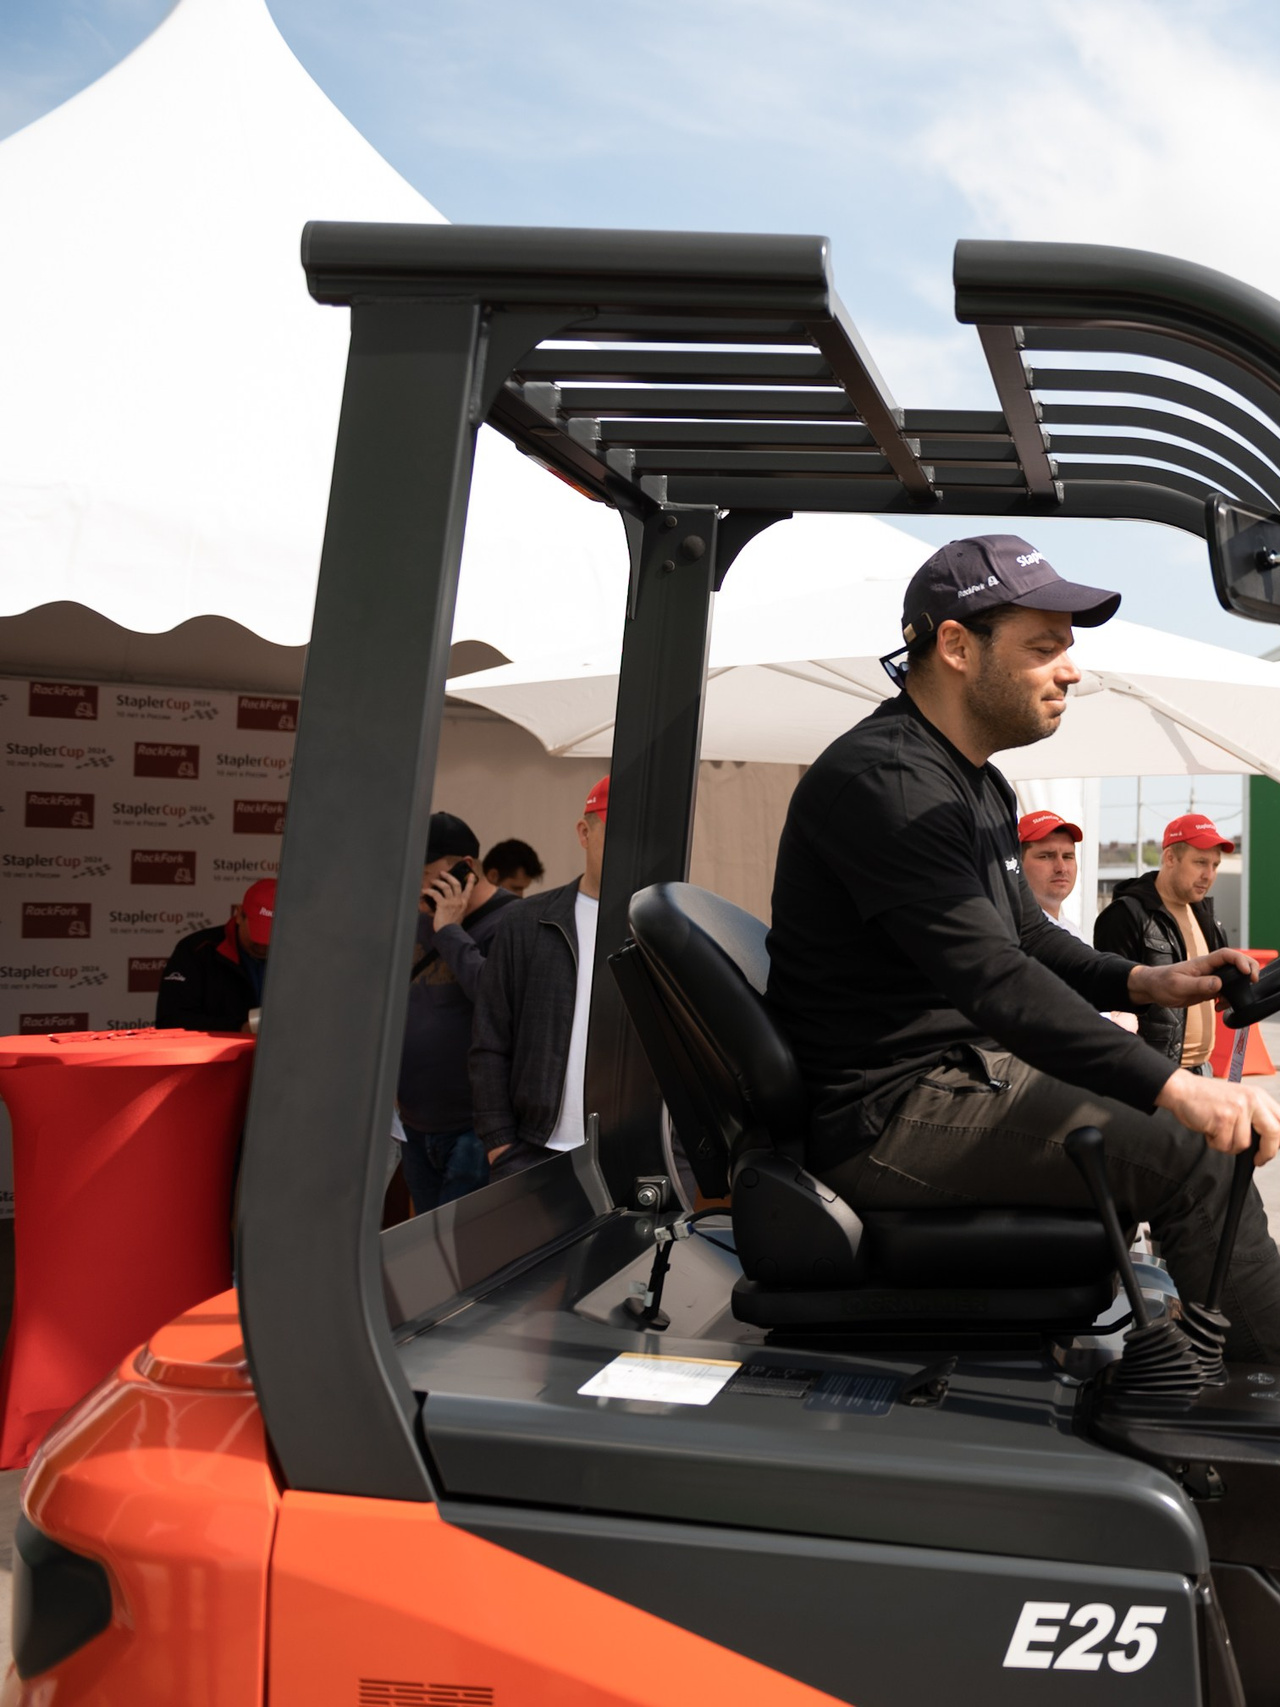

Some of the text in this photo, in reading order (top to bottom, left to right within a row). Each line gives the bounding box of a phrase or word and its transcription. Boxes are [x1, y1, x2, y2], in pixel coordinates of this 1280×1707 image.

[32, 684, 86, 697] RackFork
[116, 694, 191, 711] StaplerCup
[240, 698, 288, 711] RackFork
[6, 742, 85, 760] StaplerCup
[137, 744, 188, 757] RackFork
[217, 754, 286, 770] StaplerCup
[28, 794, 82, 807] RackFork
[112, 802, 186, 817] StaplerCup
[236, 802, 284, 814] RackFork
[2, 854, 81, 869] StaplerCup
[134, 852, 185, 864] RackFork
[25, 905, 79, 917] RackFork
[109, 910, 183, 925] StaplerCup
[22, 1016, 76, 1027] RackFork
[1002, 1600, 1168, 1674] E25
